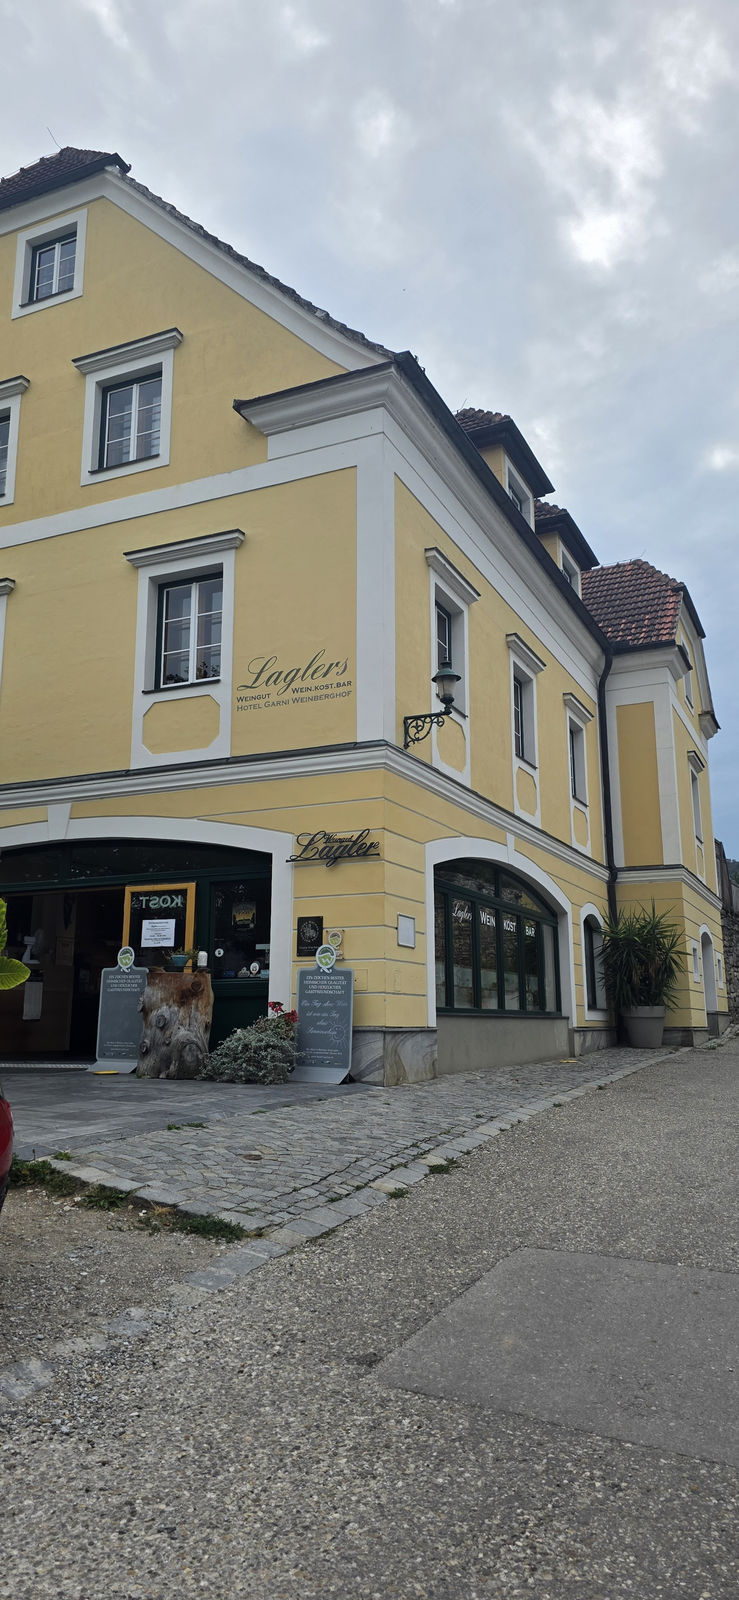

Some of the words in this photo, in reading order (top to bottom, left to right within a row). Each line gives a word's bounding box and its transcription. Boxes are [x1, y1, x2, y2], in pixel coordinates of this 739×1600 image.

[236, 648, 349, 696] Laglers
[236, 693, 271, 703] WEINGUT
[291, 680, 352, 694] WEIN.KOST.BAR
[236, 703, 262, 712] HOTEL
[264, 699, 290, 708] GARNI
[291, 690, 352, 704] WEINBERGHOF
[452, 902, 473, 923] Laglers
[480, 911, 496, 928] WEIN
[503, 920, 516, 932] KOST
[525, 926, 536, 938] BAR
